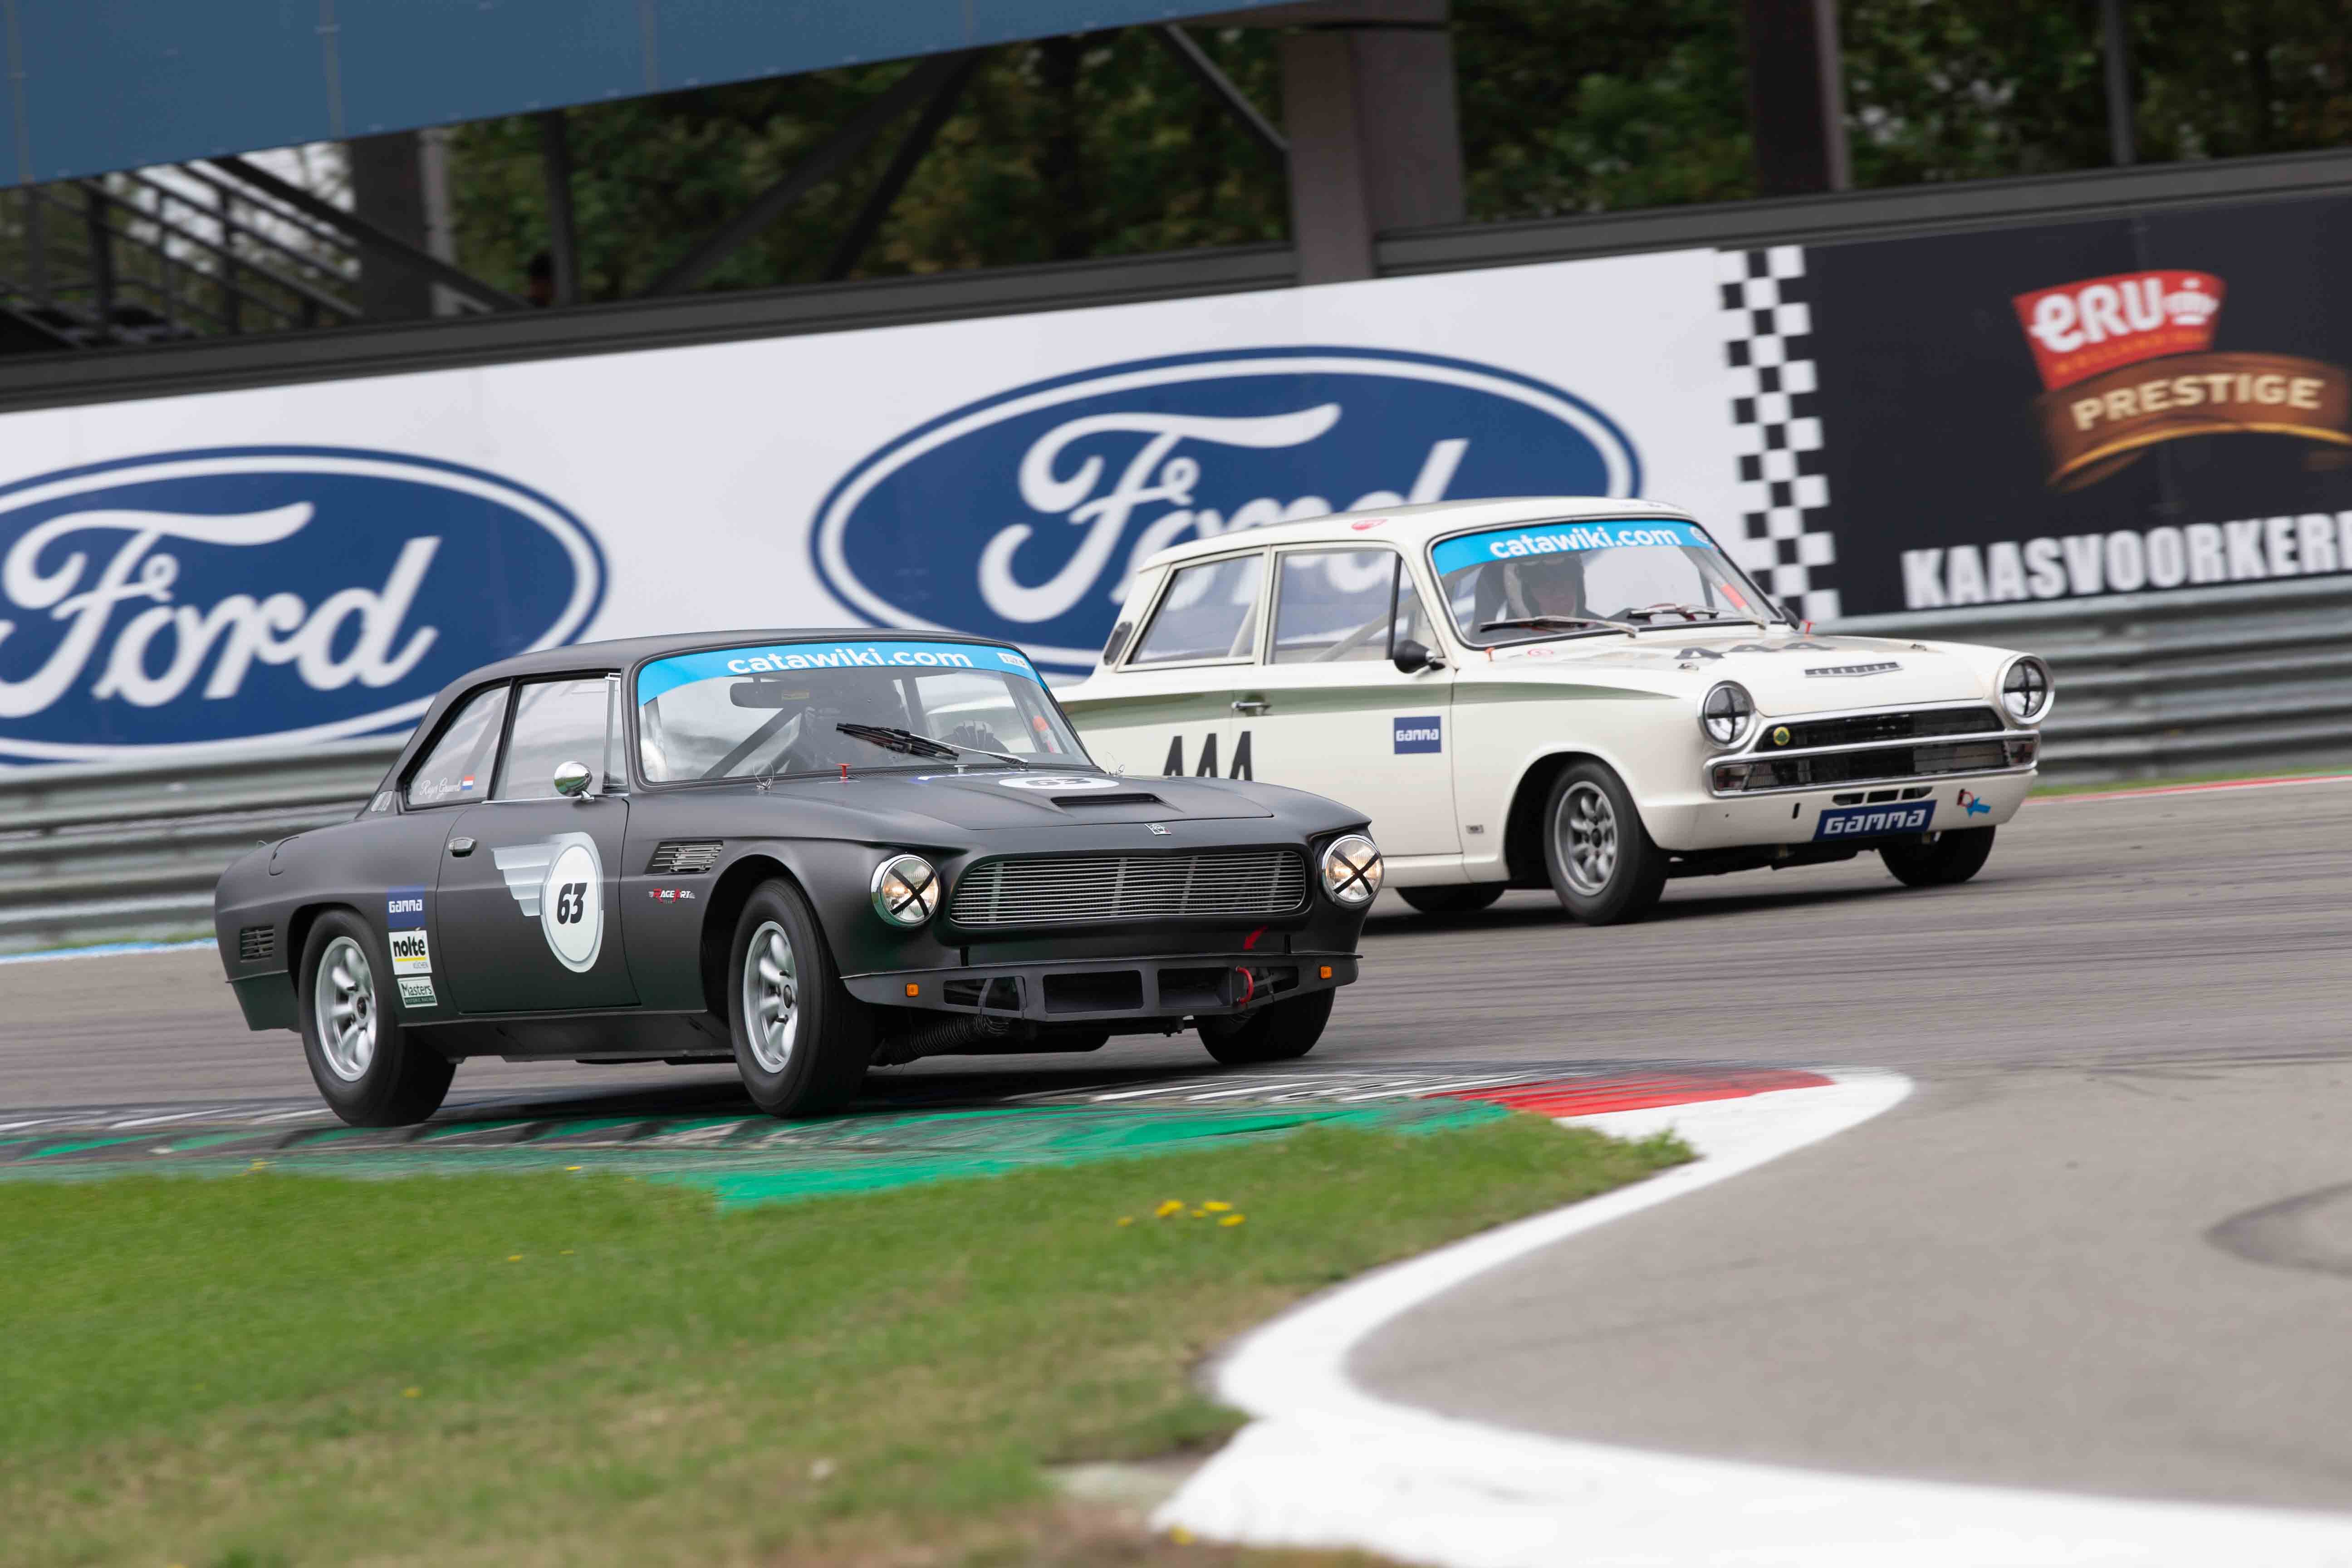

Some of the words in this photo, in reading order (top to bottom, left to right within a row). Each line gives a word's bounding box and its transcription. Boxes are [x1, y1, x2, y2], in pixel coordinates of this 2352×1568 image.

[2071, 372, 2325, 431] PRESTIGE
[1490, 526, 1682, 559] catawiki.com
[0, 501, 441, 718] Ford
[727, 647, 973, 673] catawiki.com
[557, 882, 588, 925] 63
[393, 936, 426, 957] nolte
[401, 983, 432, 996] Masters
